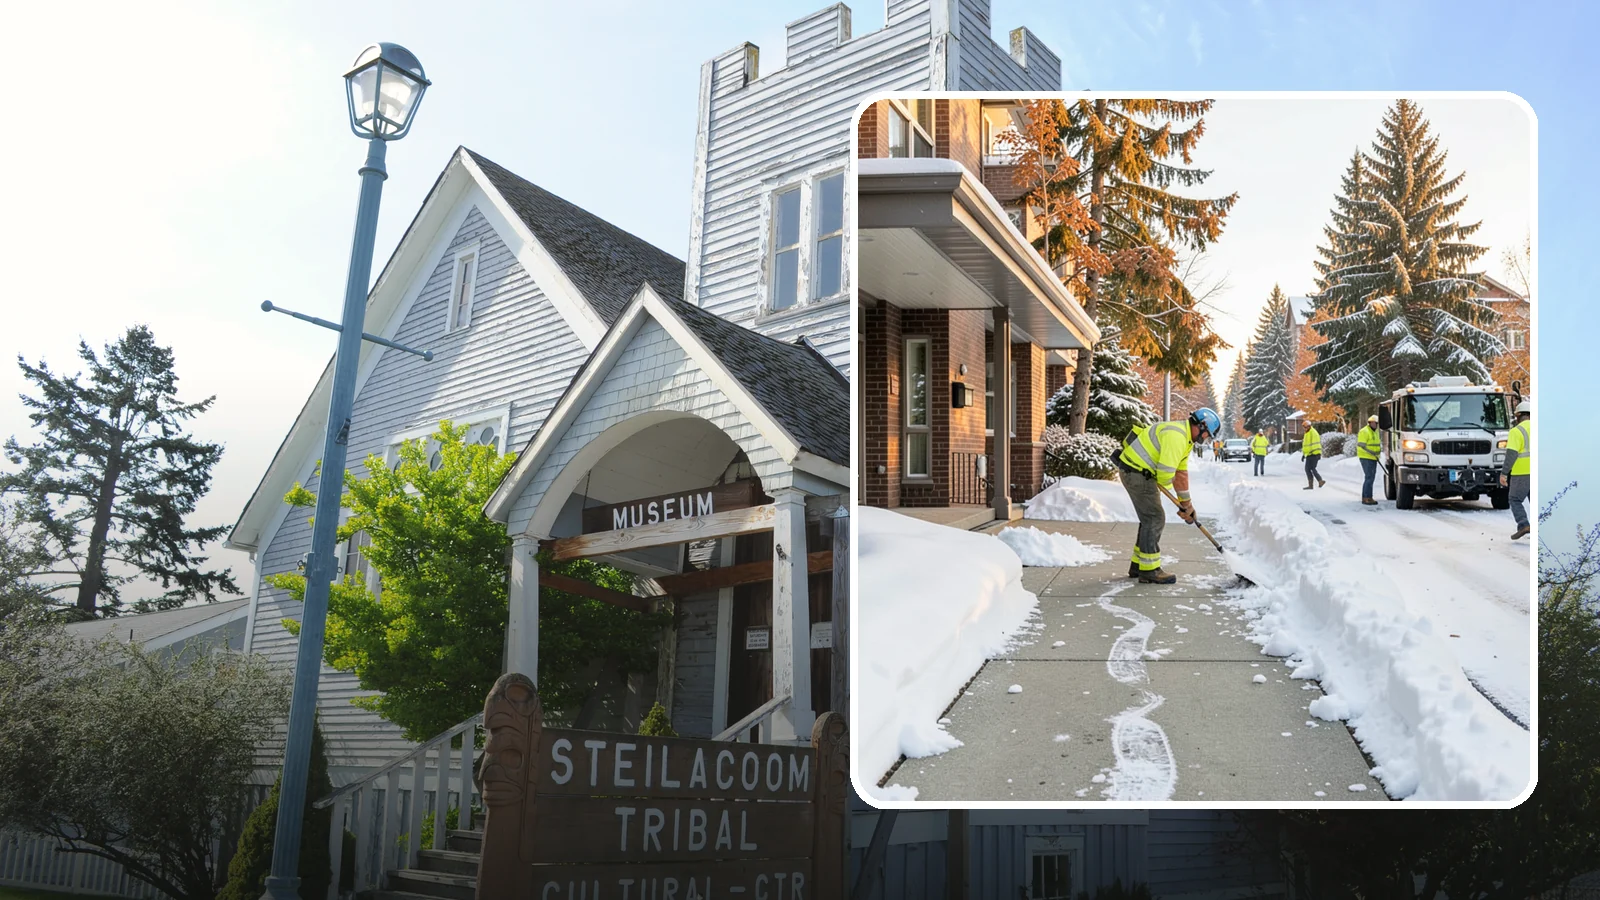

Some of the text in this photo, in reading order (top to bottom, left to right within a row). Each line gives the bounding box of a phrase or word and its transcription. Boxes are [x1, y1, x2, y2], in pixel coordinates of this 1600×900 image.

[613, 491, 713, 530] MUSEUM
[550, 738, 810, 793] STEILACOOM
[614, 806, 758, 852] TRIBAL
